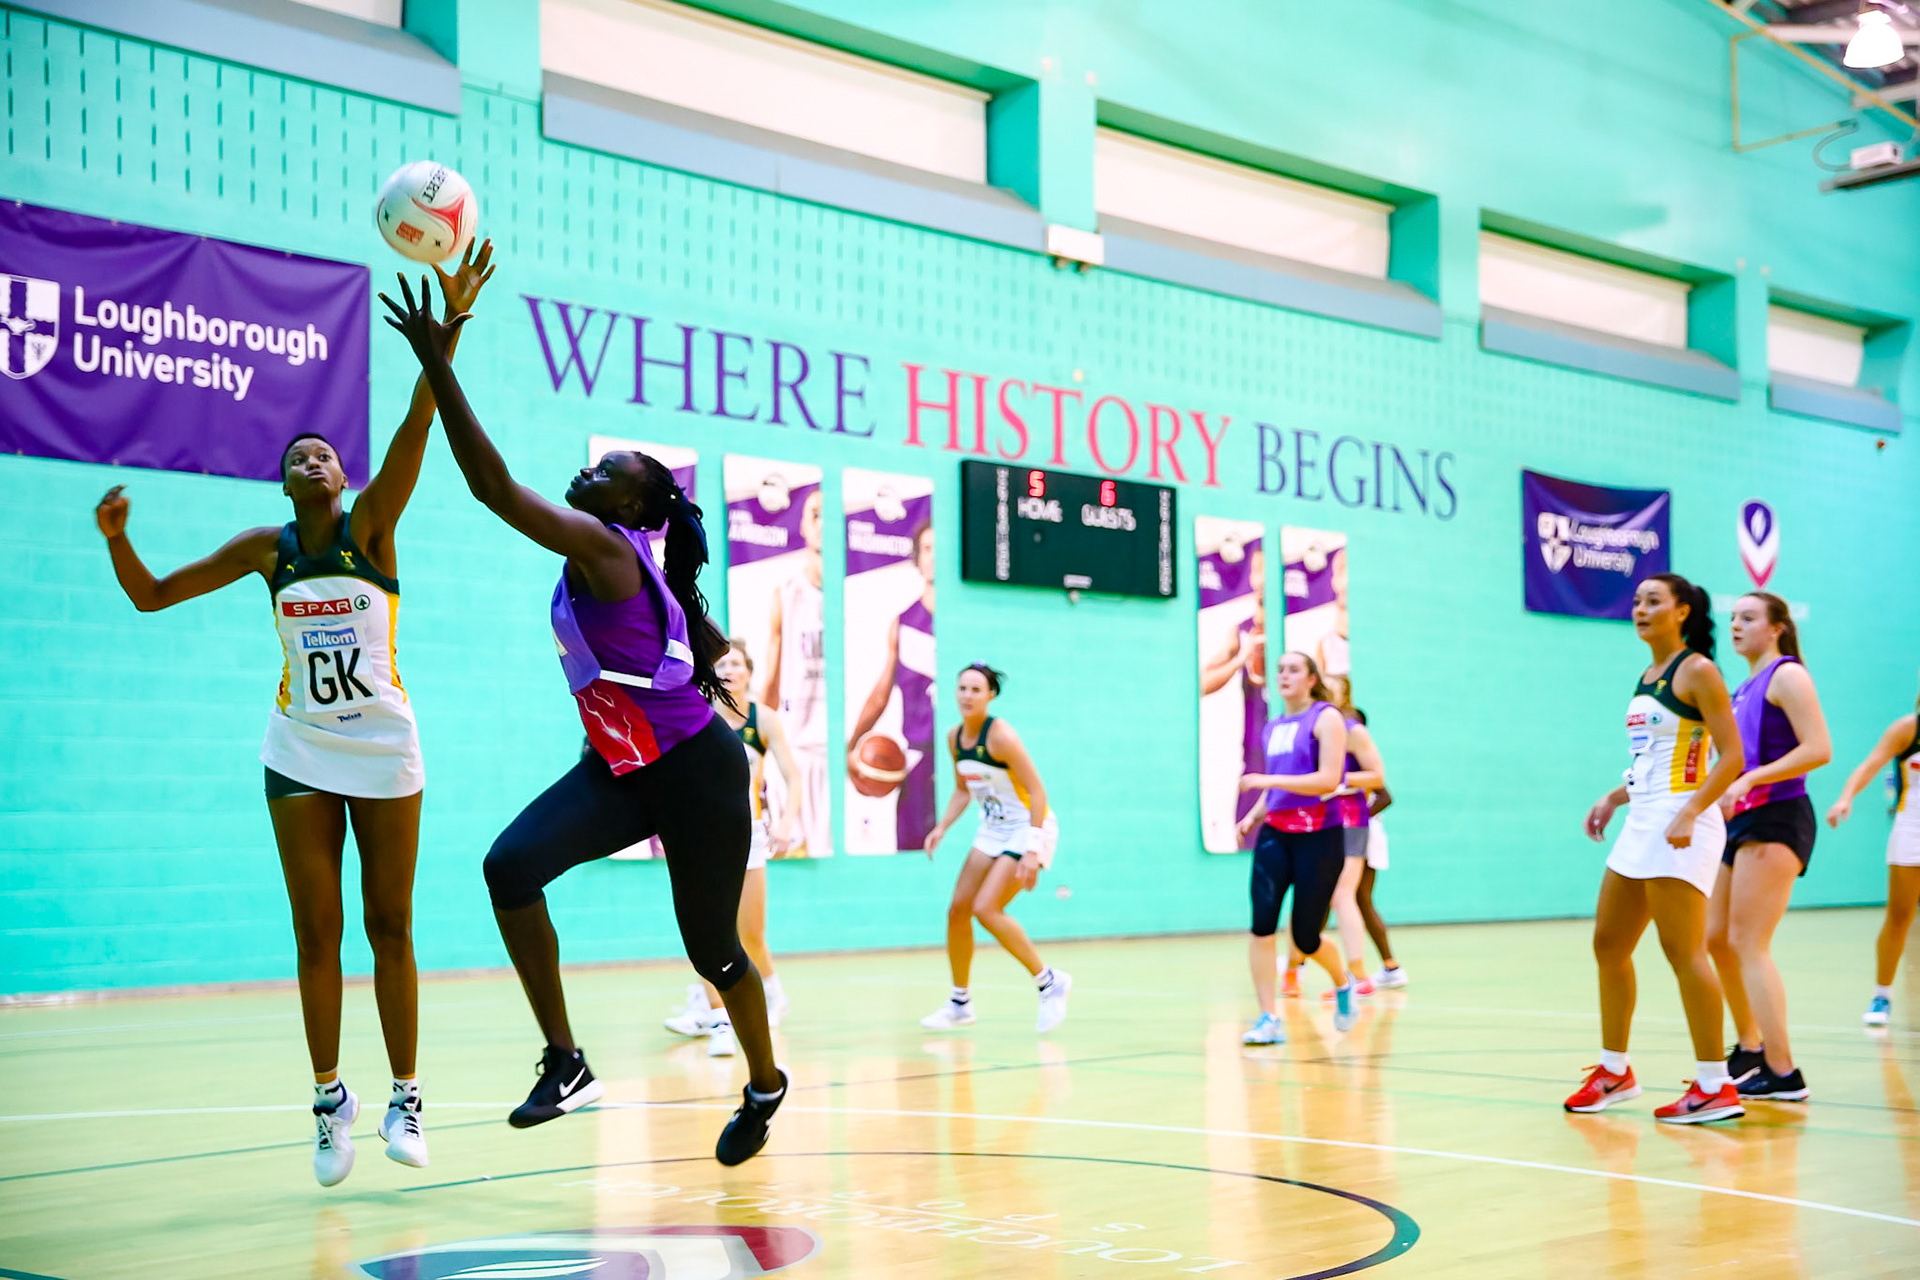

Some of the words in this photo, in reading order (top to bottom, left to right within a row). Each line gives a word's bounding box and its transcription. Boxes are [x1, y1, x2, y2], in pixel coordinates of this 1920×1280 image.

[75, 286, 328, 366] Loughborough
[73, 331, 254, 402] University
[519, 293, 877, 438] WHERE
[902, 362, 1232, 489] HISTORY
[1254, 421, 1459, 522] BEGINS
[1028, 470, 1045, 498] 5
[1099, 479, 1117, 507] 6
[1018, 496, 1063, 522] HOME
[1081, 503, 1137, 532] GUESTS
[1569, 518, 1660, 554] Loughborough
[1573, 544, 1637, 578] University
[292, 600, 350, 616] SPAR
[303, 630, 356, 647] Telkom
[307, 647, 374, 705] GK
